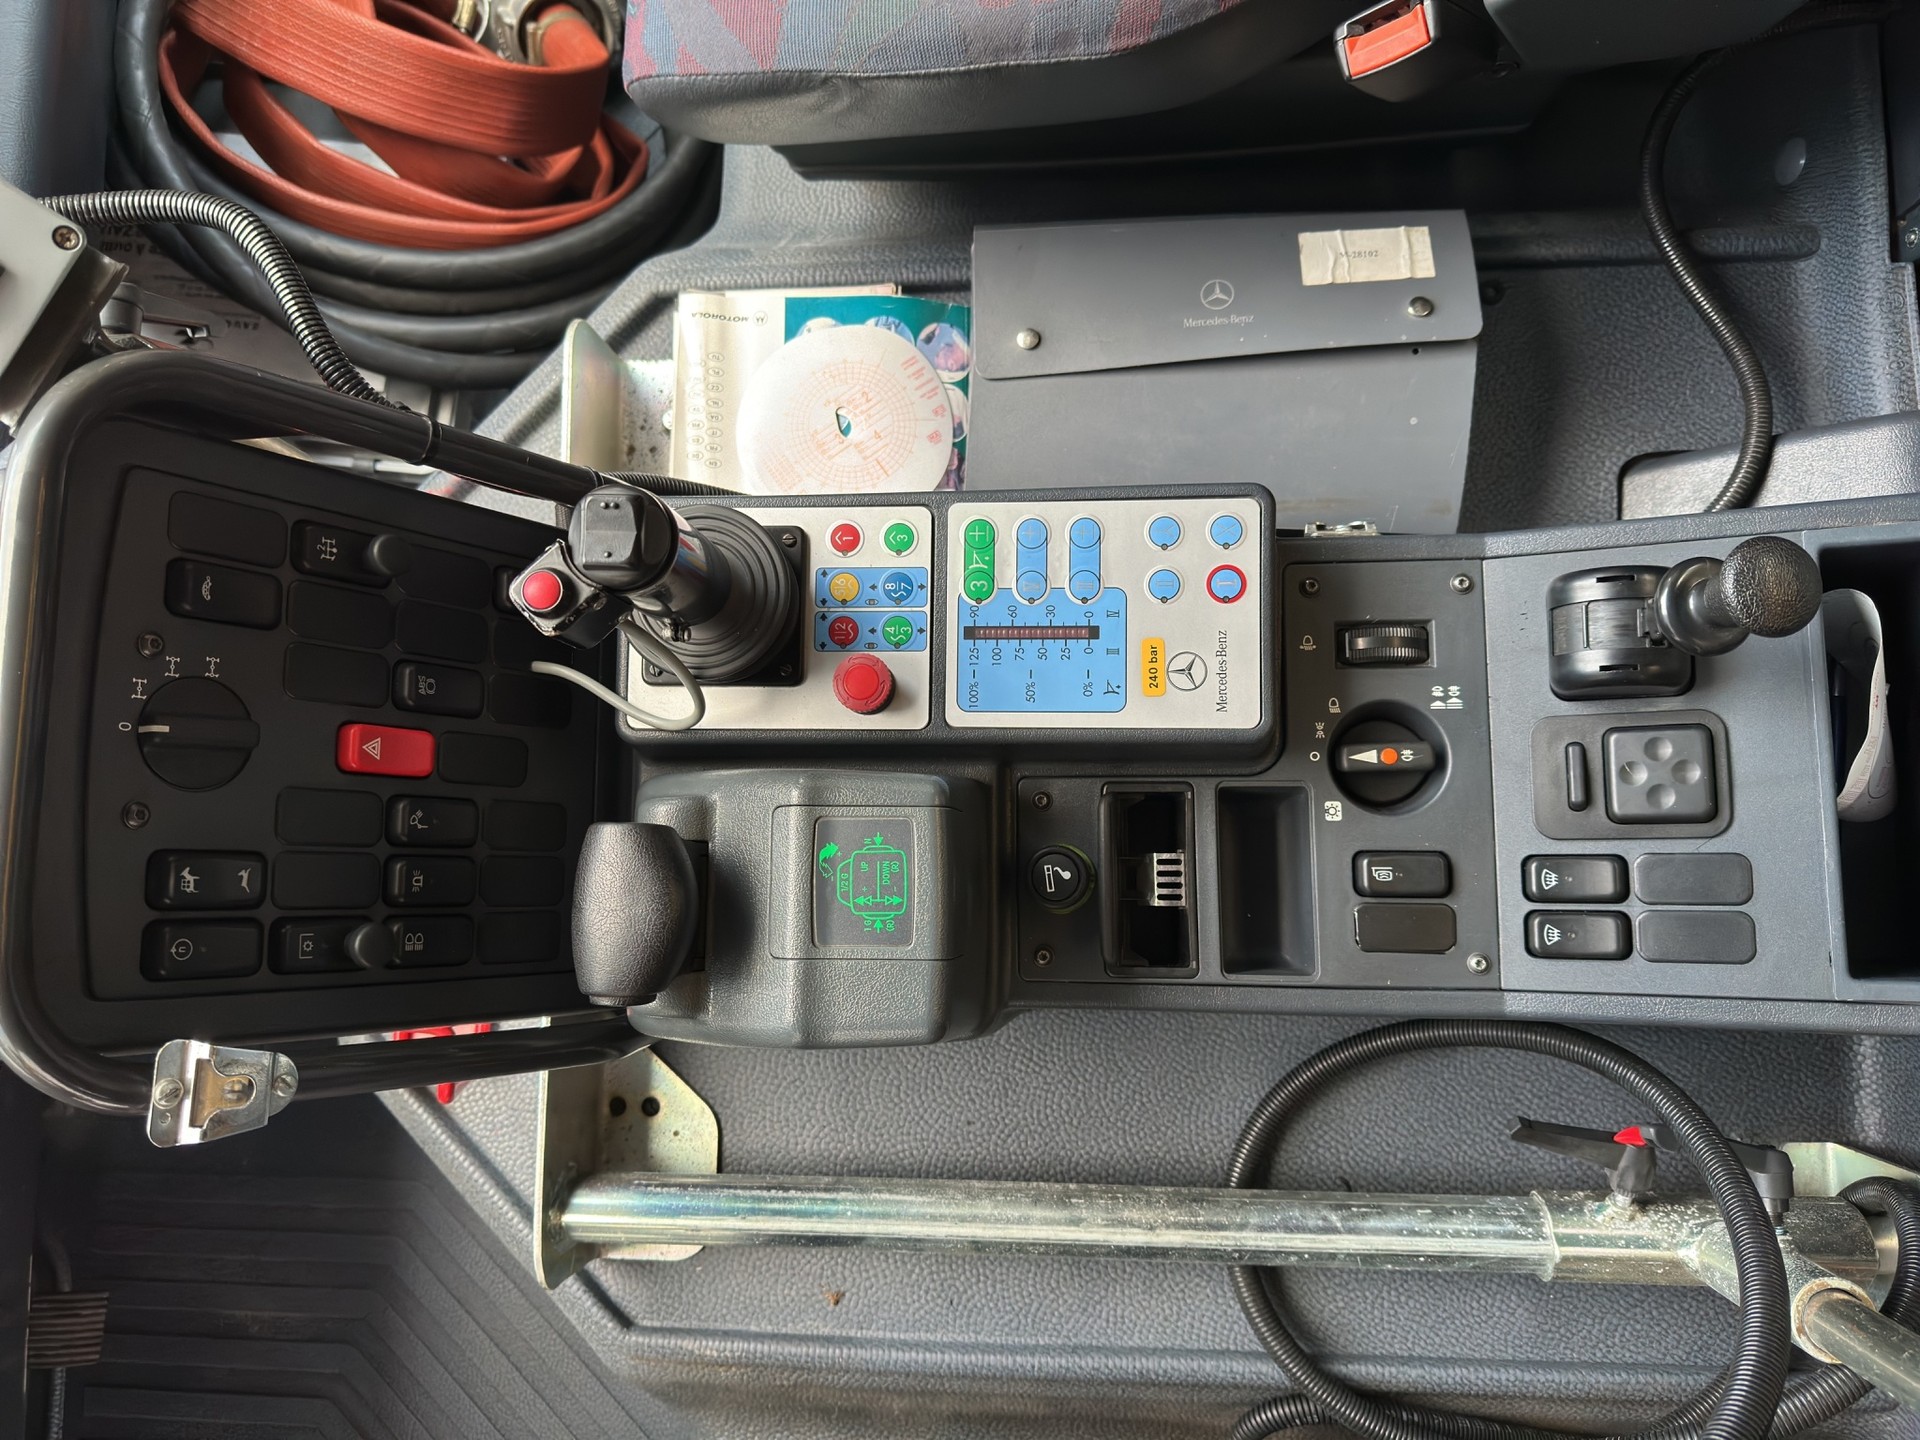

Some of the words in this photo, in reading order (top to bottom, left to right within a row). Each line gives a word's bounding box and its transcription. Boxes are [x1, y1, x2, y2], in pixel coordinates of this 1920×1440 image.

[691, 312, 749, 323] MOTOROLA
[1183, 314, 1255, 328] Mercedes-Benz
[896, 534, 908, 542] 3
[970, 580, 988, 592] 3
[969, 605, 980, 619] 90
[1007, 605, 1017, 619] 60
[1046, 605, 1056, 618] 30
[1084, 611, 1094, 619] 0
[969, 647, 979, 666] 125
[992, 647, 1002, 666] 100
[1015, 647, 1025, 661] 75
[1038, 647, 1048, 661] 50
[1061, 647, 1071, 661] 25
[1084, 647, 1094, 655] 0
[1147, 644, 1159, 664] bar
[1148, 667, 1159, 689] 240
[1215, 630, 1228, 713] Mercedes-Benz
[418, 675, 426, 695] ABS
[1026, 681, 1036, 703] 50%
[1083, 681, 1093, 697] 0%
[969, 681, 979, 709] 100%
[118, 721, 132, 732] 0
[861, 861, 869, 872] UP
[882, 861, 891, 885] DOWN
[891, 861, 899, 873] (R)
[841, 880, 849, 892] 1/2
[886, 920, 895, 932] (R)
